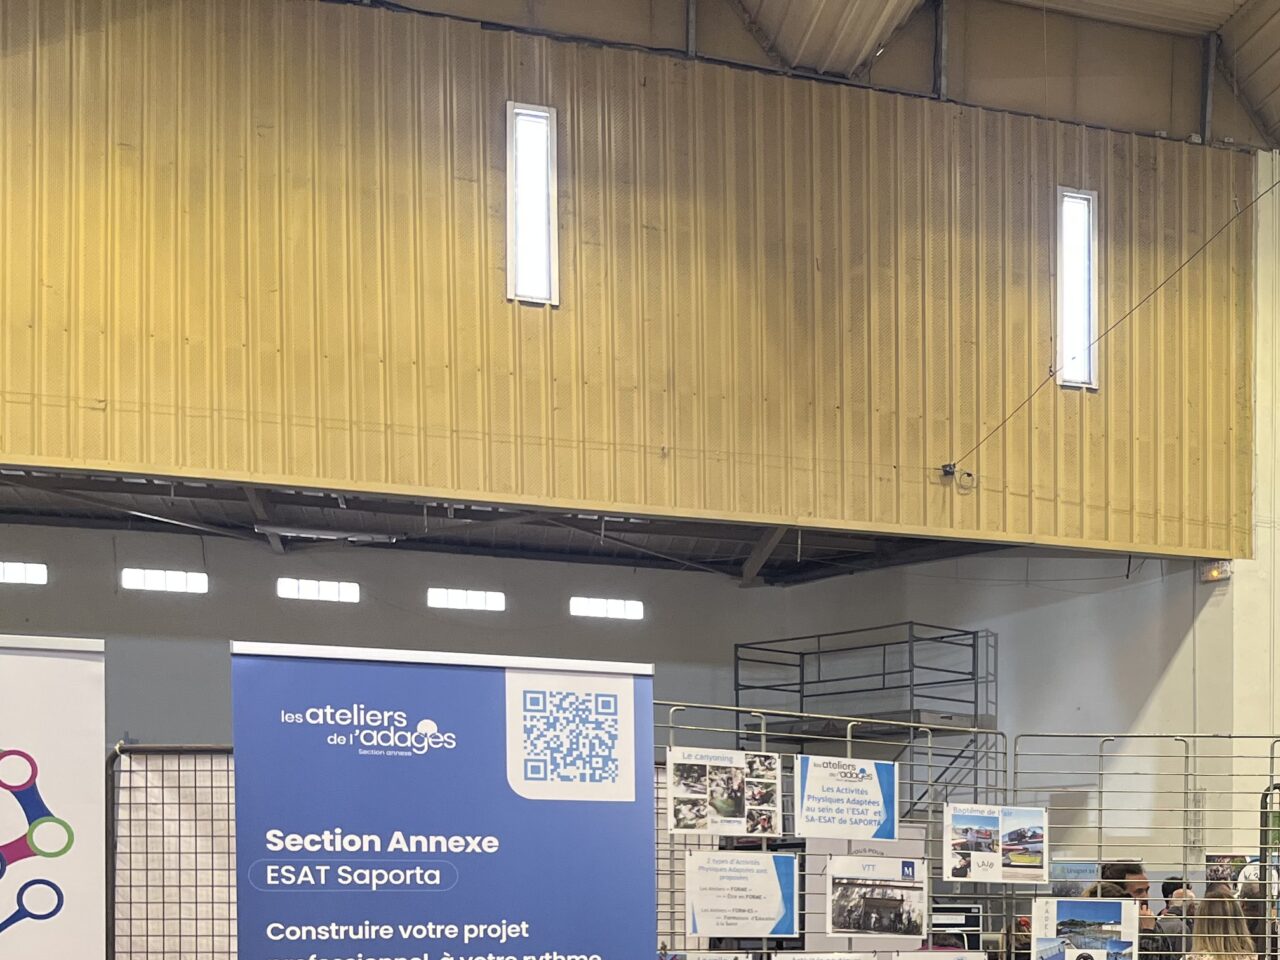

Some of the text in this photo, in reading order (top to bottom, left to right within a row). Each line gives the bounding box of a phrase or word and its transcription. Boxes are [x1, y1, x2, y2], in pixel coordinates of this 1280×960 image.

[281, 704, 407, 727] les ateliers
[327, 733, 346, 745] de
[694, 753, 734, 764] canyoning
[266, 828, 500, 853] Section Annexe
[266, 865, 441, 891] ESAT Saporta
[266, 919, 529, 944] Construire votre projet
